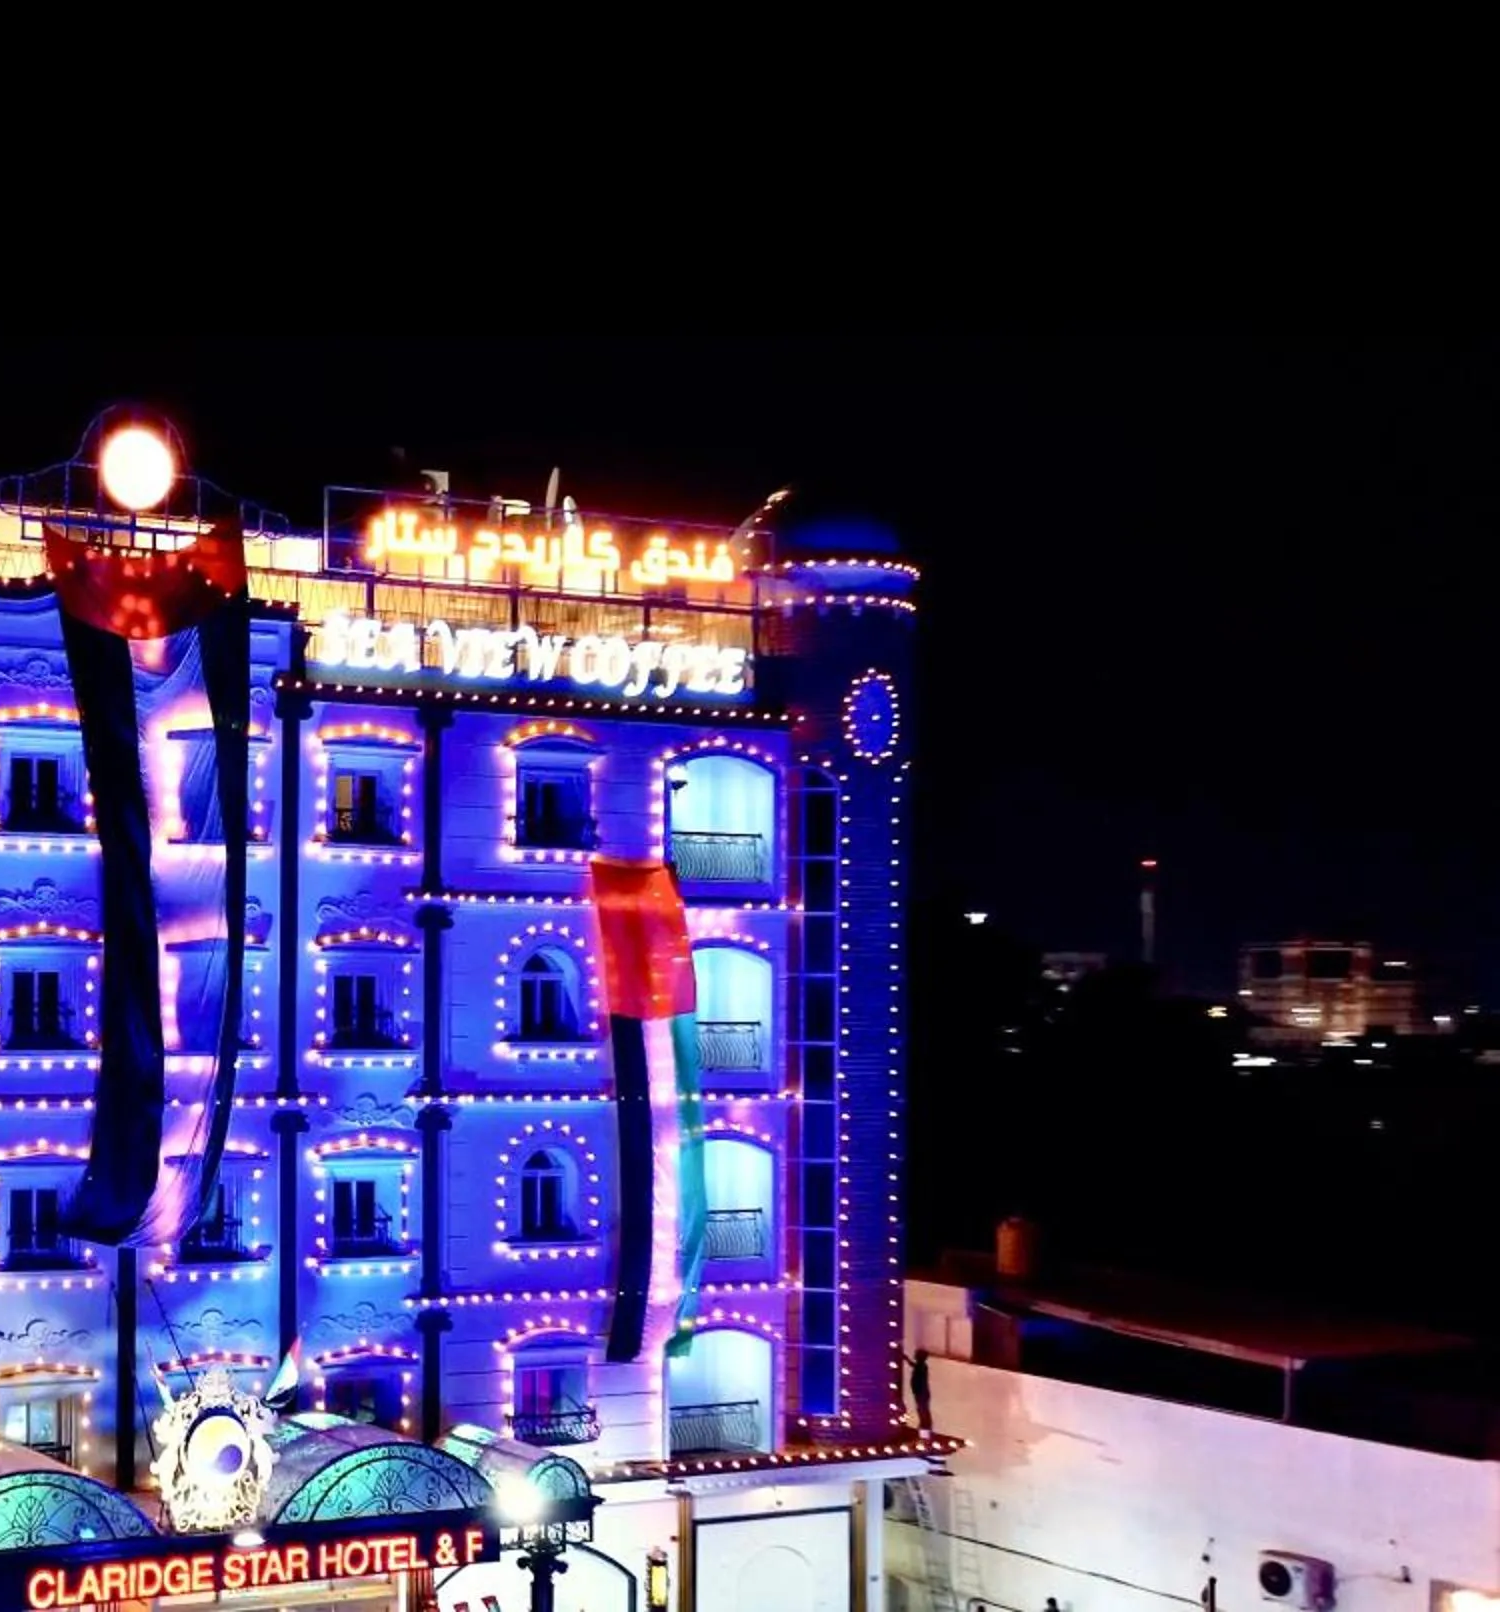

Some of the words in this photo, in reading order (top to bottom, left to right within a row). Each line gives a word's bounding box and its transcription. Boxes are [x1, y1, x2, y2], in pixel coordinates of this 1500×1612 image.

[364, 510, 457, 559] ستار
[630, 536, 735, 585] فندق
[322, 612, 421, 673] SEA
[426, 619, 567, 682] VIEW
[570, 635, 746, 698] COFFEE
[28, 1555, 215, 1608] CLARIDGE
[222, 1544, 310, 1586] STAR
[318, 1534, 427, 1579] HOTEL
[434, 1530, 460, 1567] &
[465, 1529, 484, 1564] F
